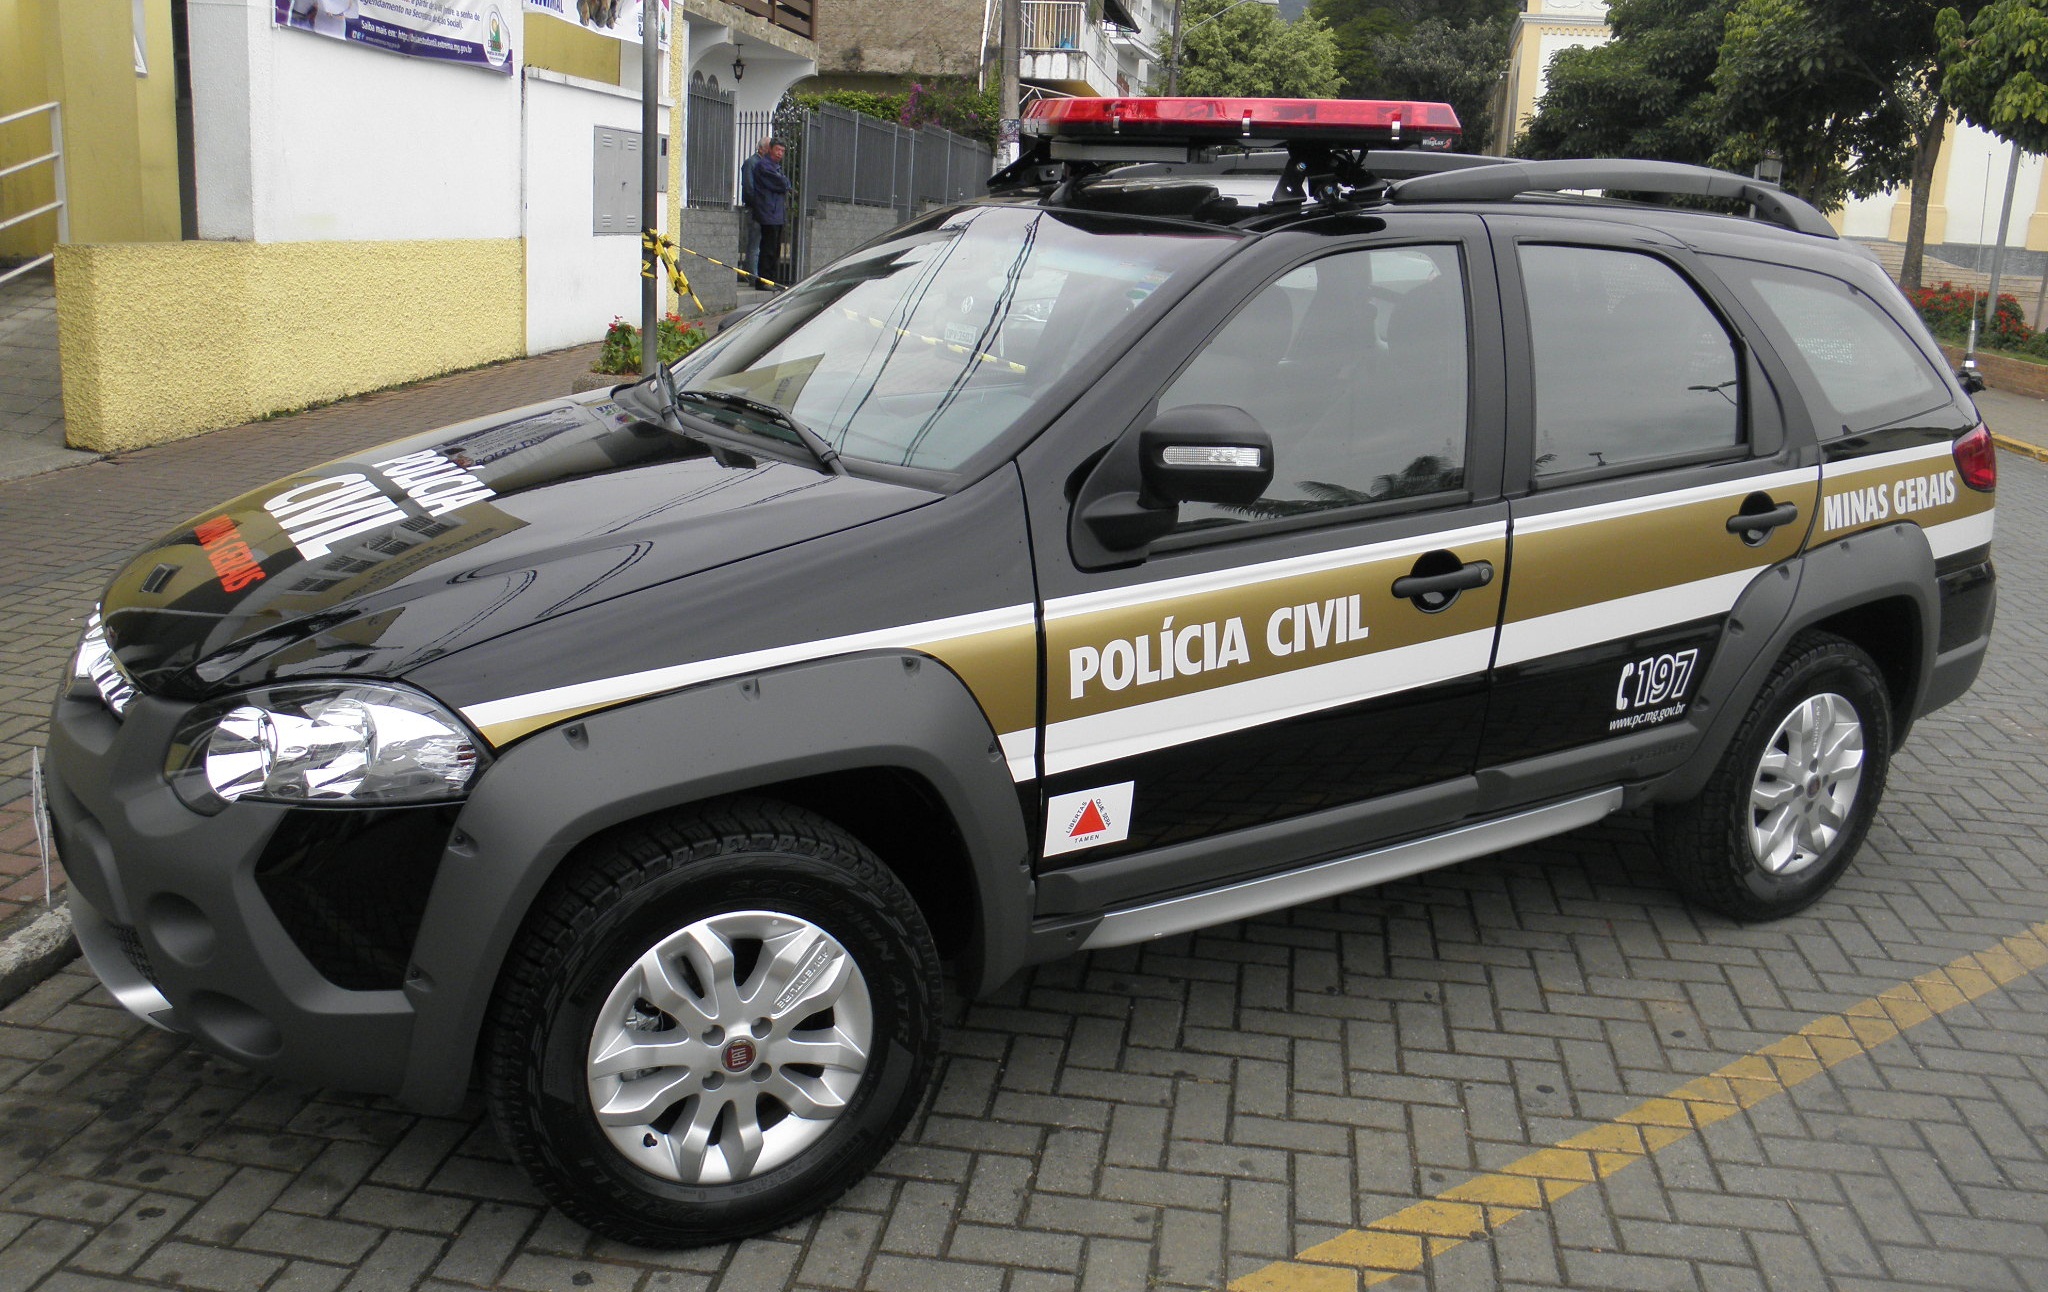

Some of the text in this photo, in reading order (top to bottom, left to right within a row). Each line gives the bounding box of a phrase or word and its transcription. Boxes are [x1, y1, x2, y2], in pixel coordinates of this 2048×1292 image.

[405, 7, 411, 15] na
[460, 10, 473, 19] senha
[474, 13, 480, 21] de
[361, 20, 375, 32] Saiba
[375, 26, 387, 36] mais
[371, 449, 497, 517] POLÍCIA
[264, 473, 409, 561] CIVIL
[1823, 469, 1956, 532] MINAS GERAIS
[194, 514, 267, 593] MINAS GERAIS
[1069, 594, 1369, 700] POLÍCIA CIVIL
[1634, 648, 1698, 707] 197
[1609, 701, 1687, 731] www.pc.mg.gov.br
[1066, 801, 1088, 834] LIBERTAS
[1074, 834, 1100, 844] TAMEN
[731, 1047, 747, 1067] FIAT
